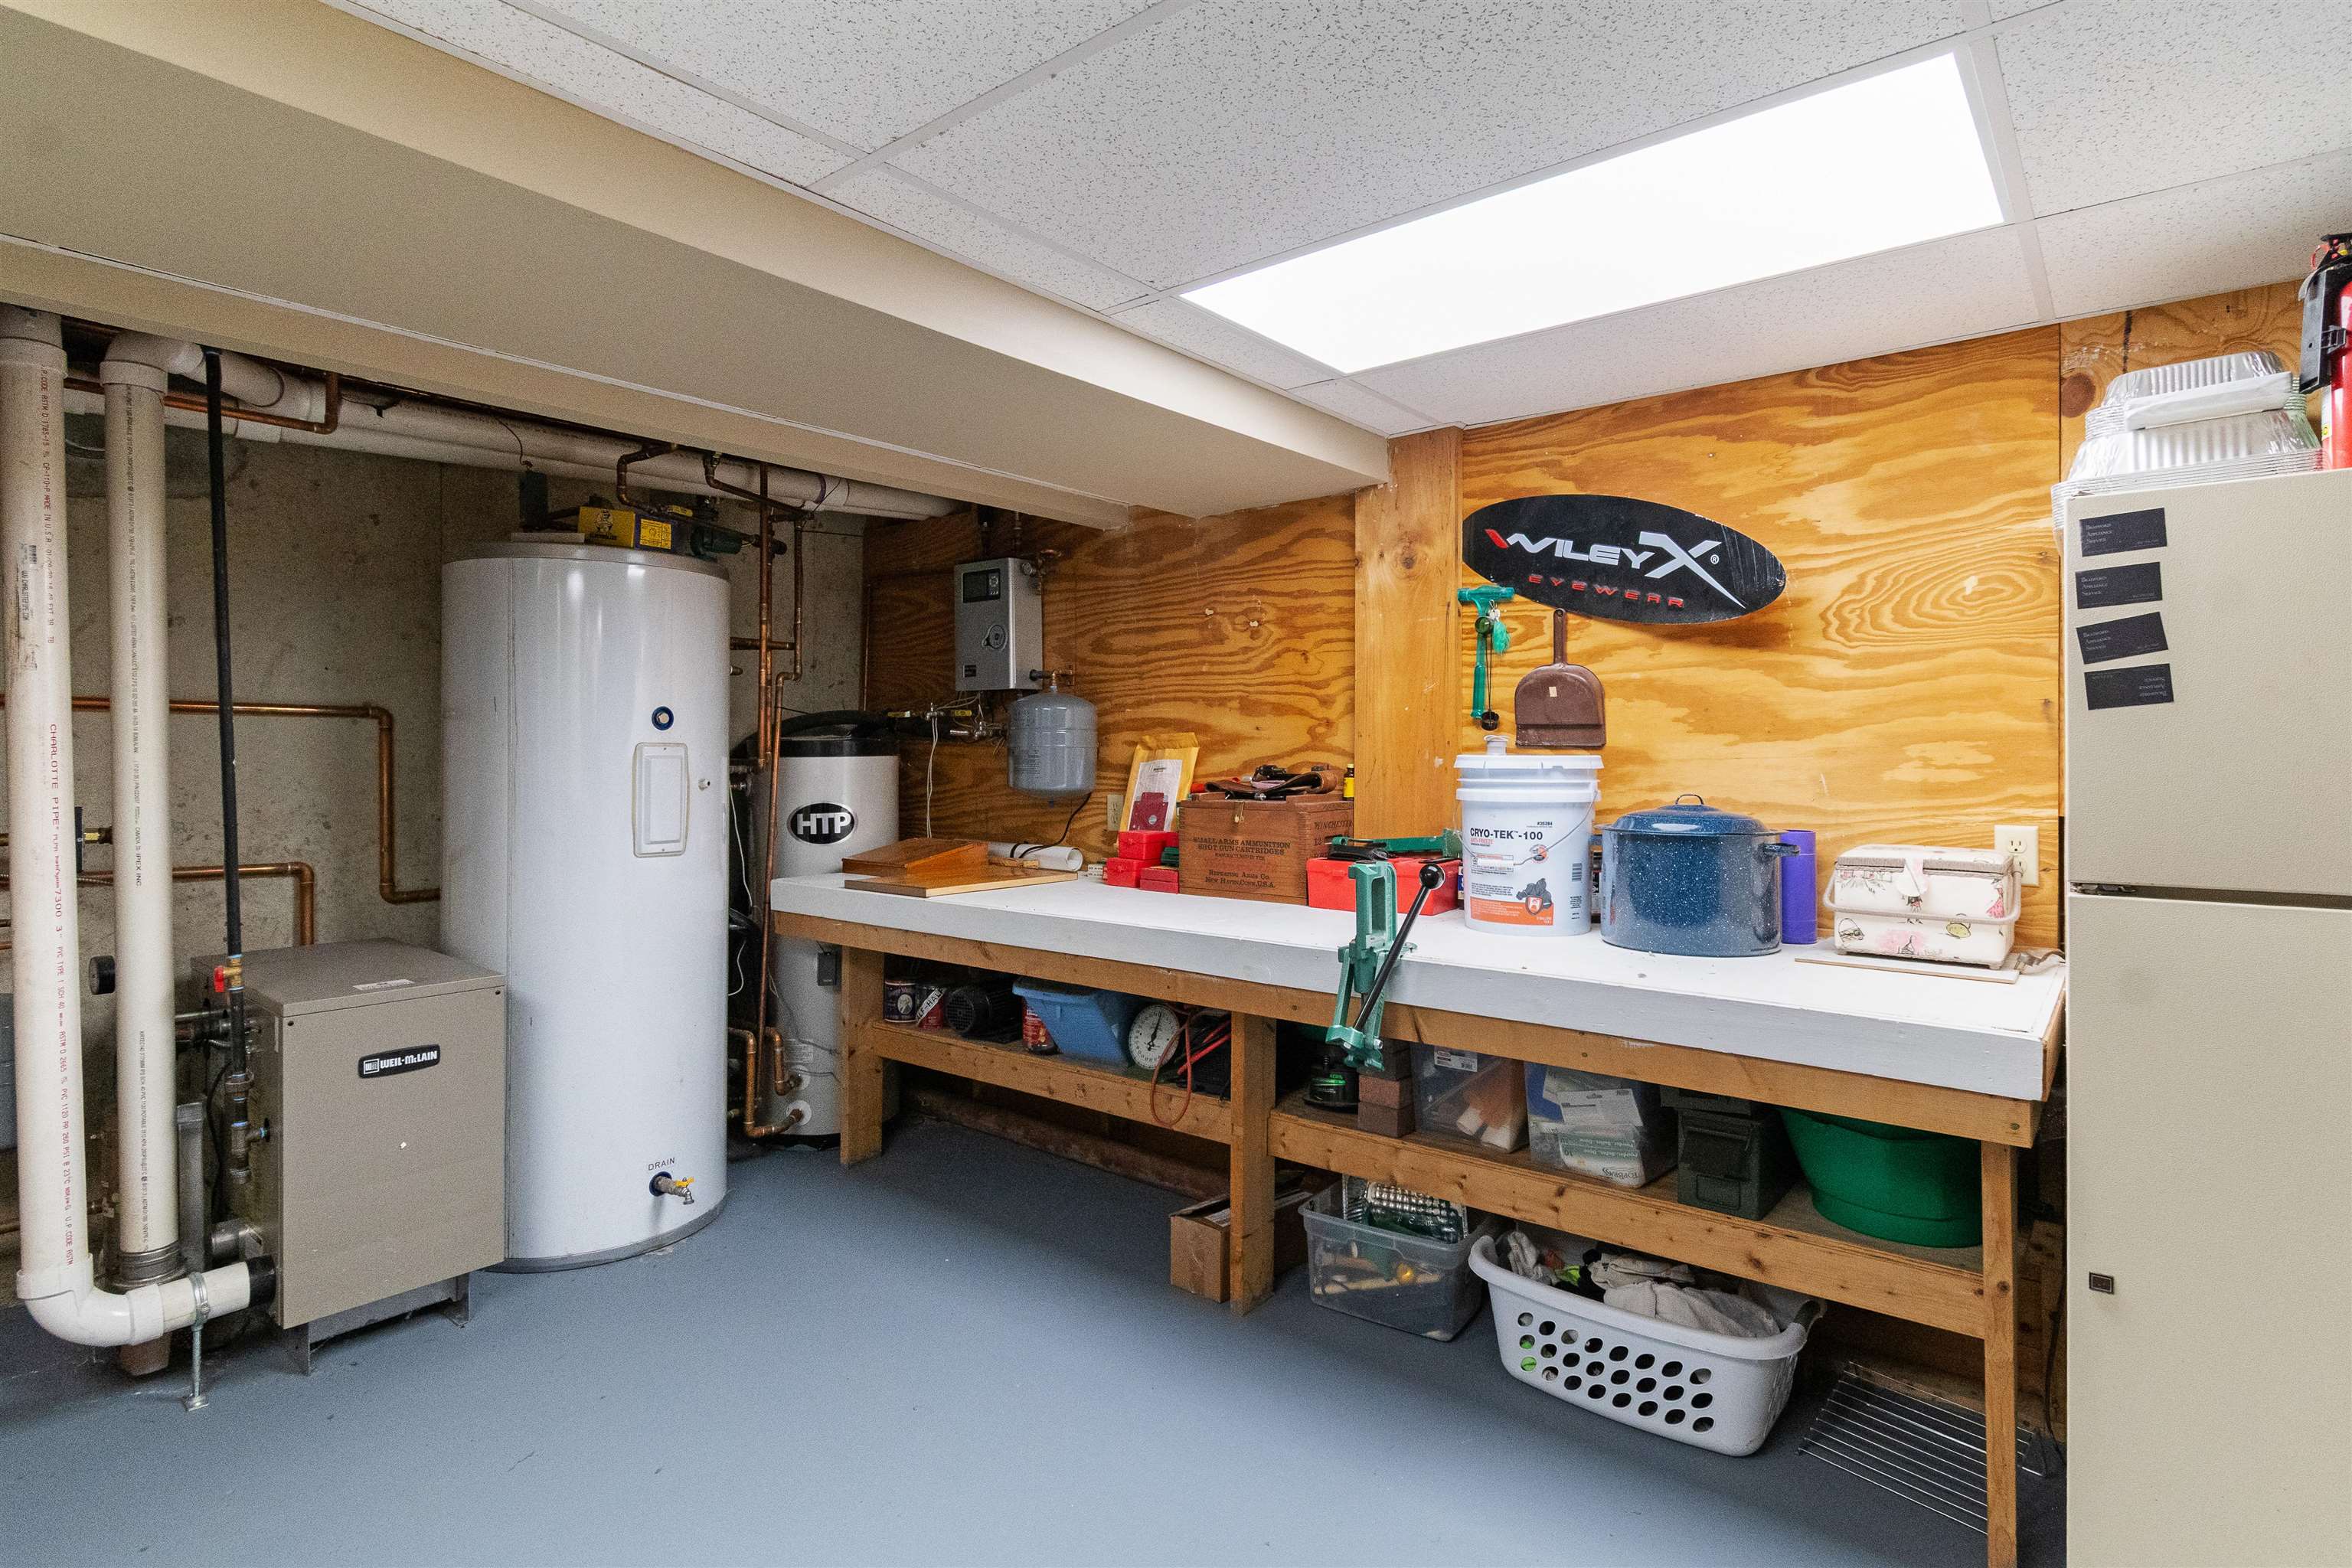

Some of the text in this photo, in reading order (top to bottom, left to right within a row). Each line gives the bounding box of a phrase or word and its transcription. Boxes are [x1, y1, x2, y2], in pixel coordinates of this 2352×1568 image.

[1528, 574, 1684, 608] EYEWEAR
[50, 724, 59, 789] CHARLOTTE
[796, 812, 851, 835] HTP
[1193, 836, 1291, 849] SMALL ARMS AMMUNITION
[1236, 846, 1285, 855] CARTRIDGES
[648, 1157, 675, 1171] DRAIN
